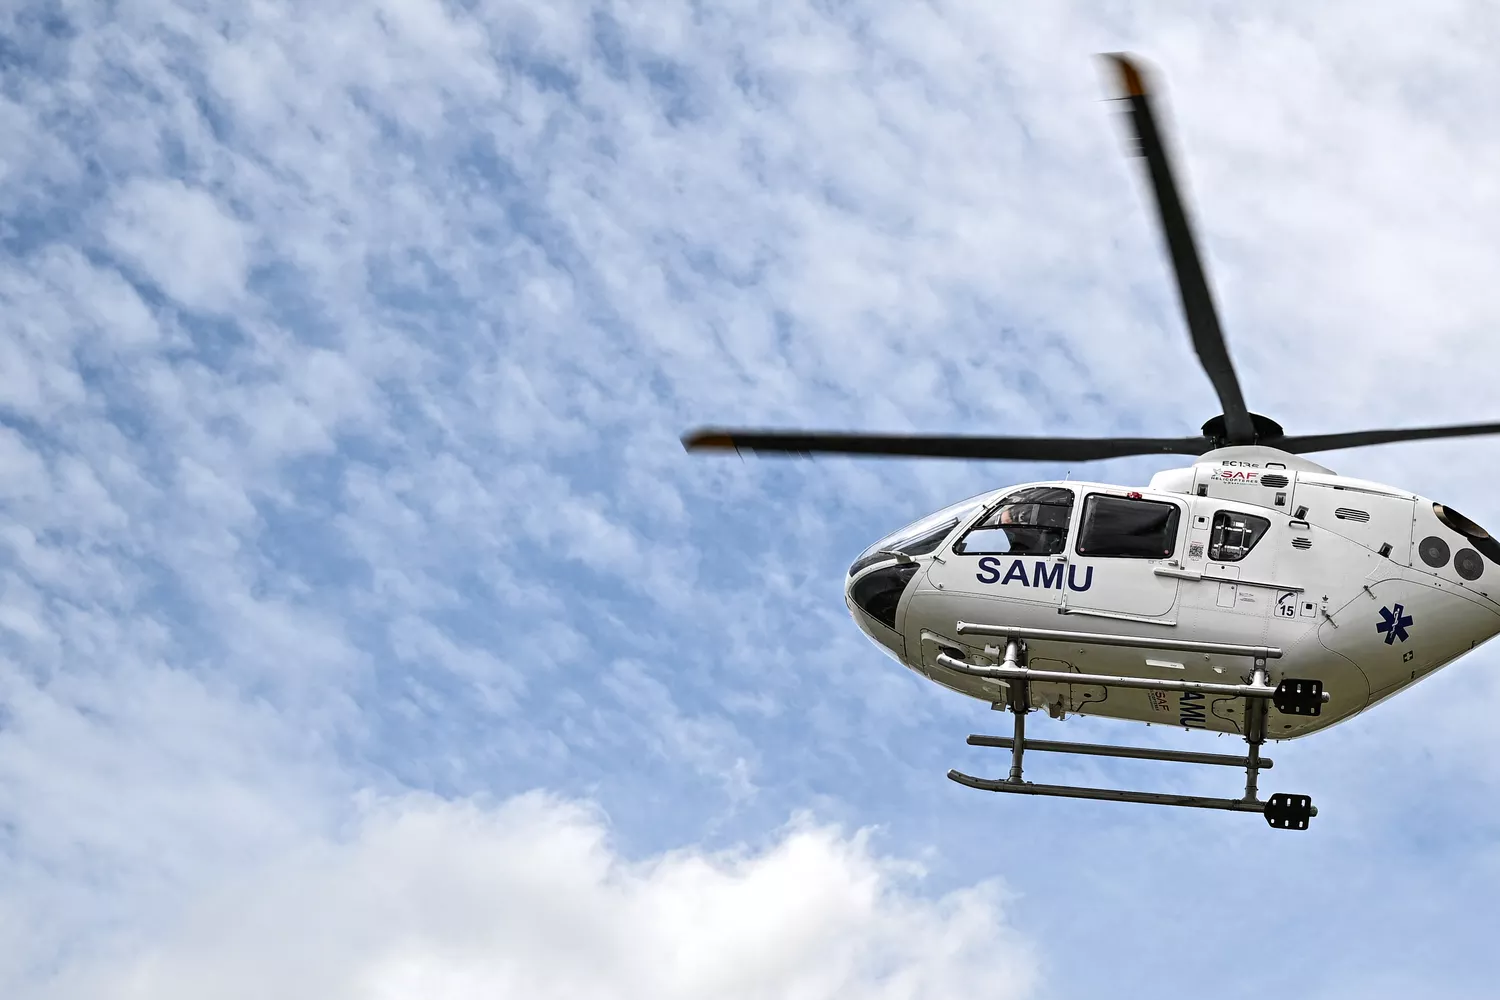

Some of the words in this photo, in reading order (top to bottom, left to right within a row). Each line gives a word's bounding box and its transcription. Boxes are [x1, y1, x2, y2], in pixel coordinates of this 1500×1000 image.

[1221, 470, 1259, 479] SAF
[976, 557, 1093, 592] SAMU
[1280, 604, 1294, 616] 15
[1180, 690, 1206, 728] AMU
